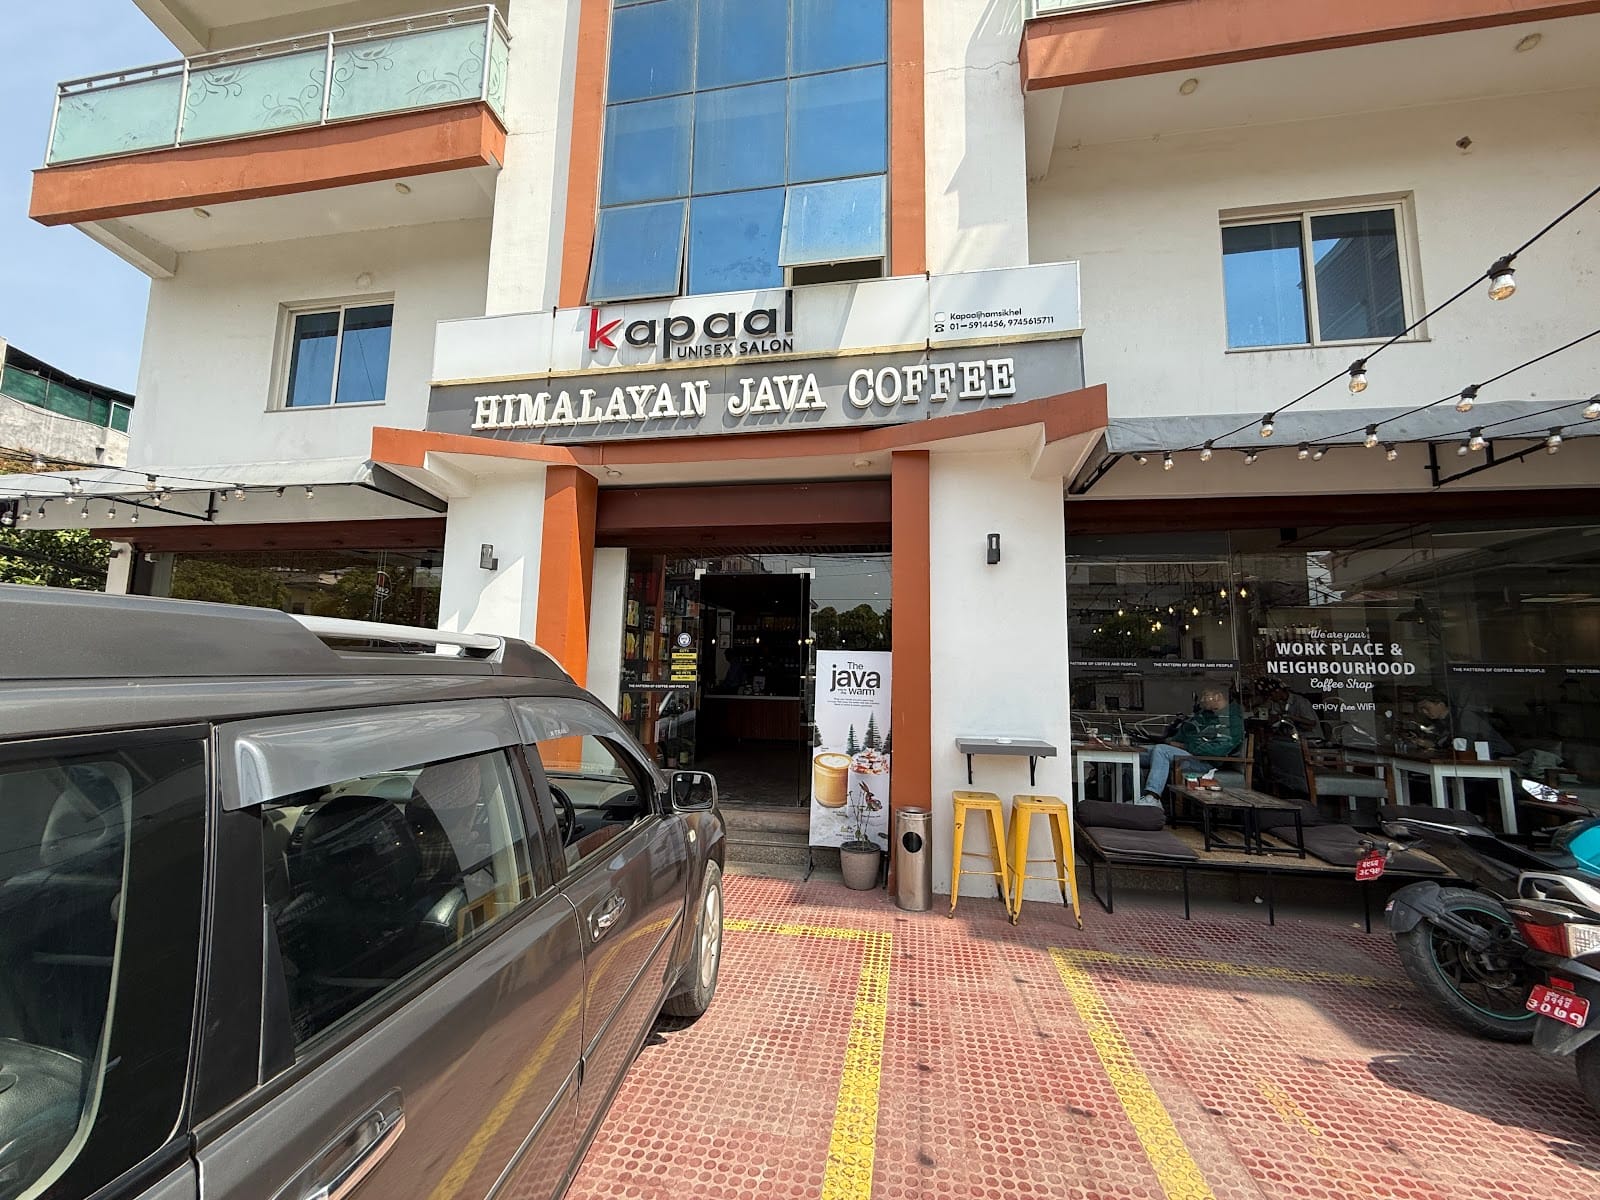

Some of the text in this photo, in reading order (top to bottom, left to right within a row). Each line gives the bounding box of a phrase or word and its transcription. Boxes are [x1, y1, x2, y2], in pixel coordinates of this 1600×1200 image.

[588, 289, 794, 360] kapaal
[1007, 316, 1055, 327] 9745615711
[677, 338, 794, 360] UNISEX SALON
[470, 357, 1017, 431] HIMALAYAN JAVA COFFEE
[1310, 629, 1367, 641] We are your
[1276, 642, 1403, 657] WORK PLACE &
[847, 661, 864, 670] The
[1266, 660, 1416, 675] NEIGHBOURHOOD
[829, 663, 881, 692] java
[1310, 677, 1374, 692] Coffee Shop
[848, 687, 876, 697] warm
[1312, 702, 1338, 712] enjoy
[1340, 702, 1356, 713] free
